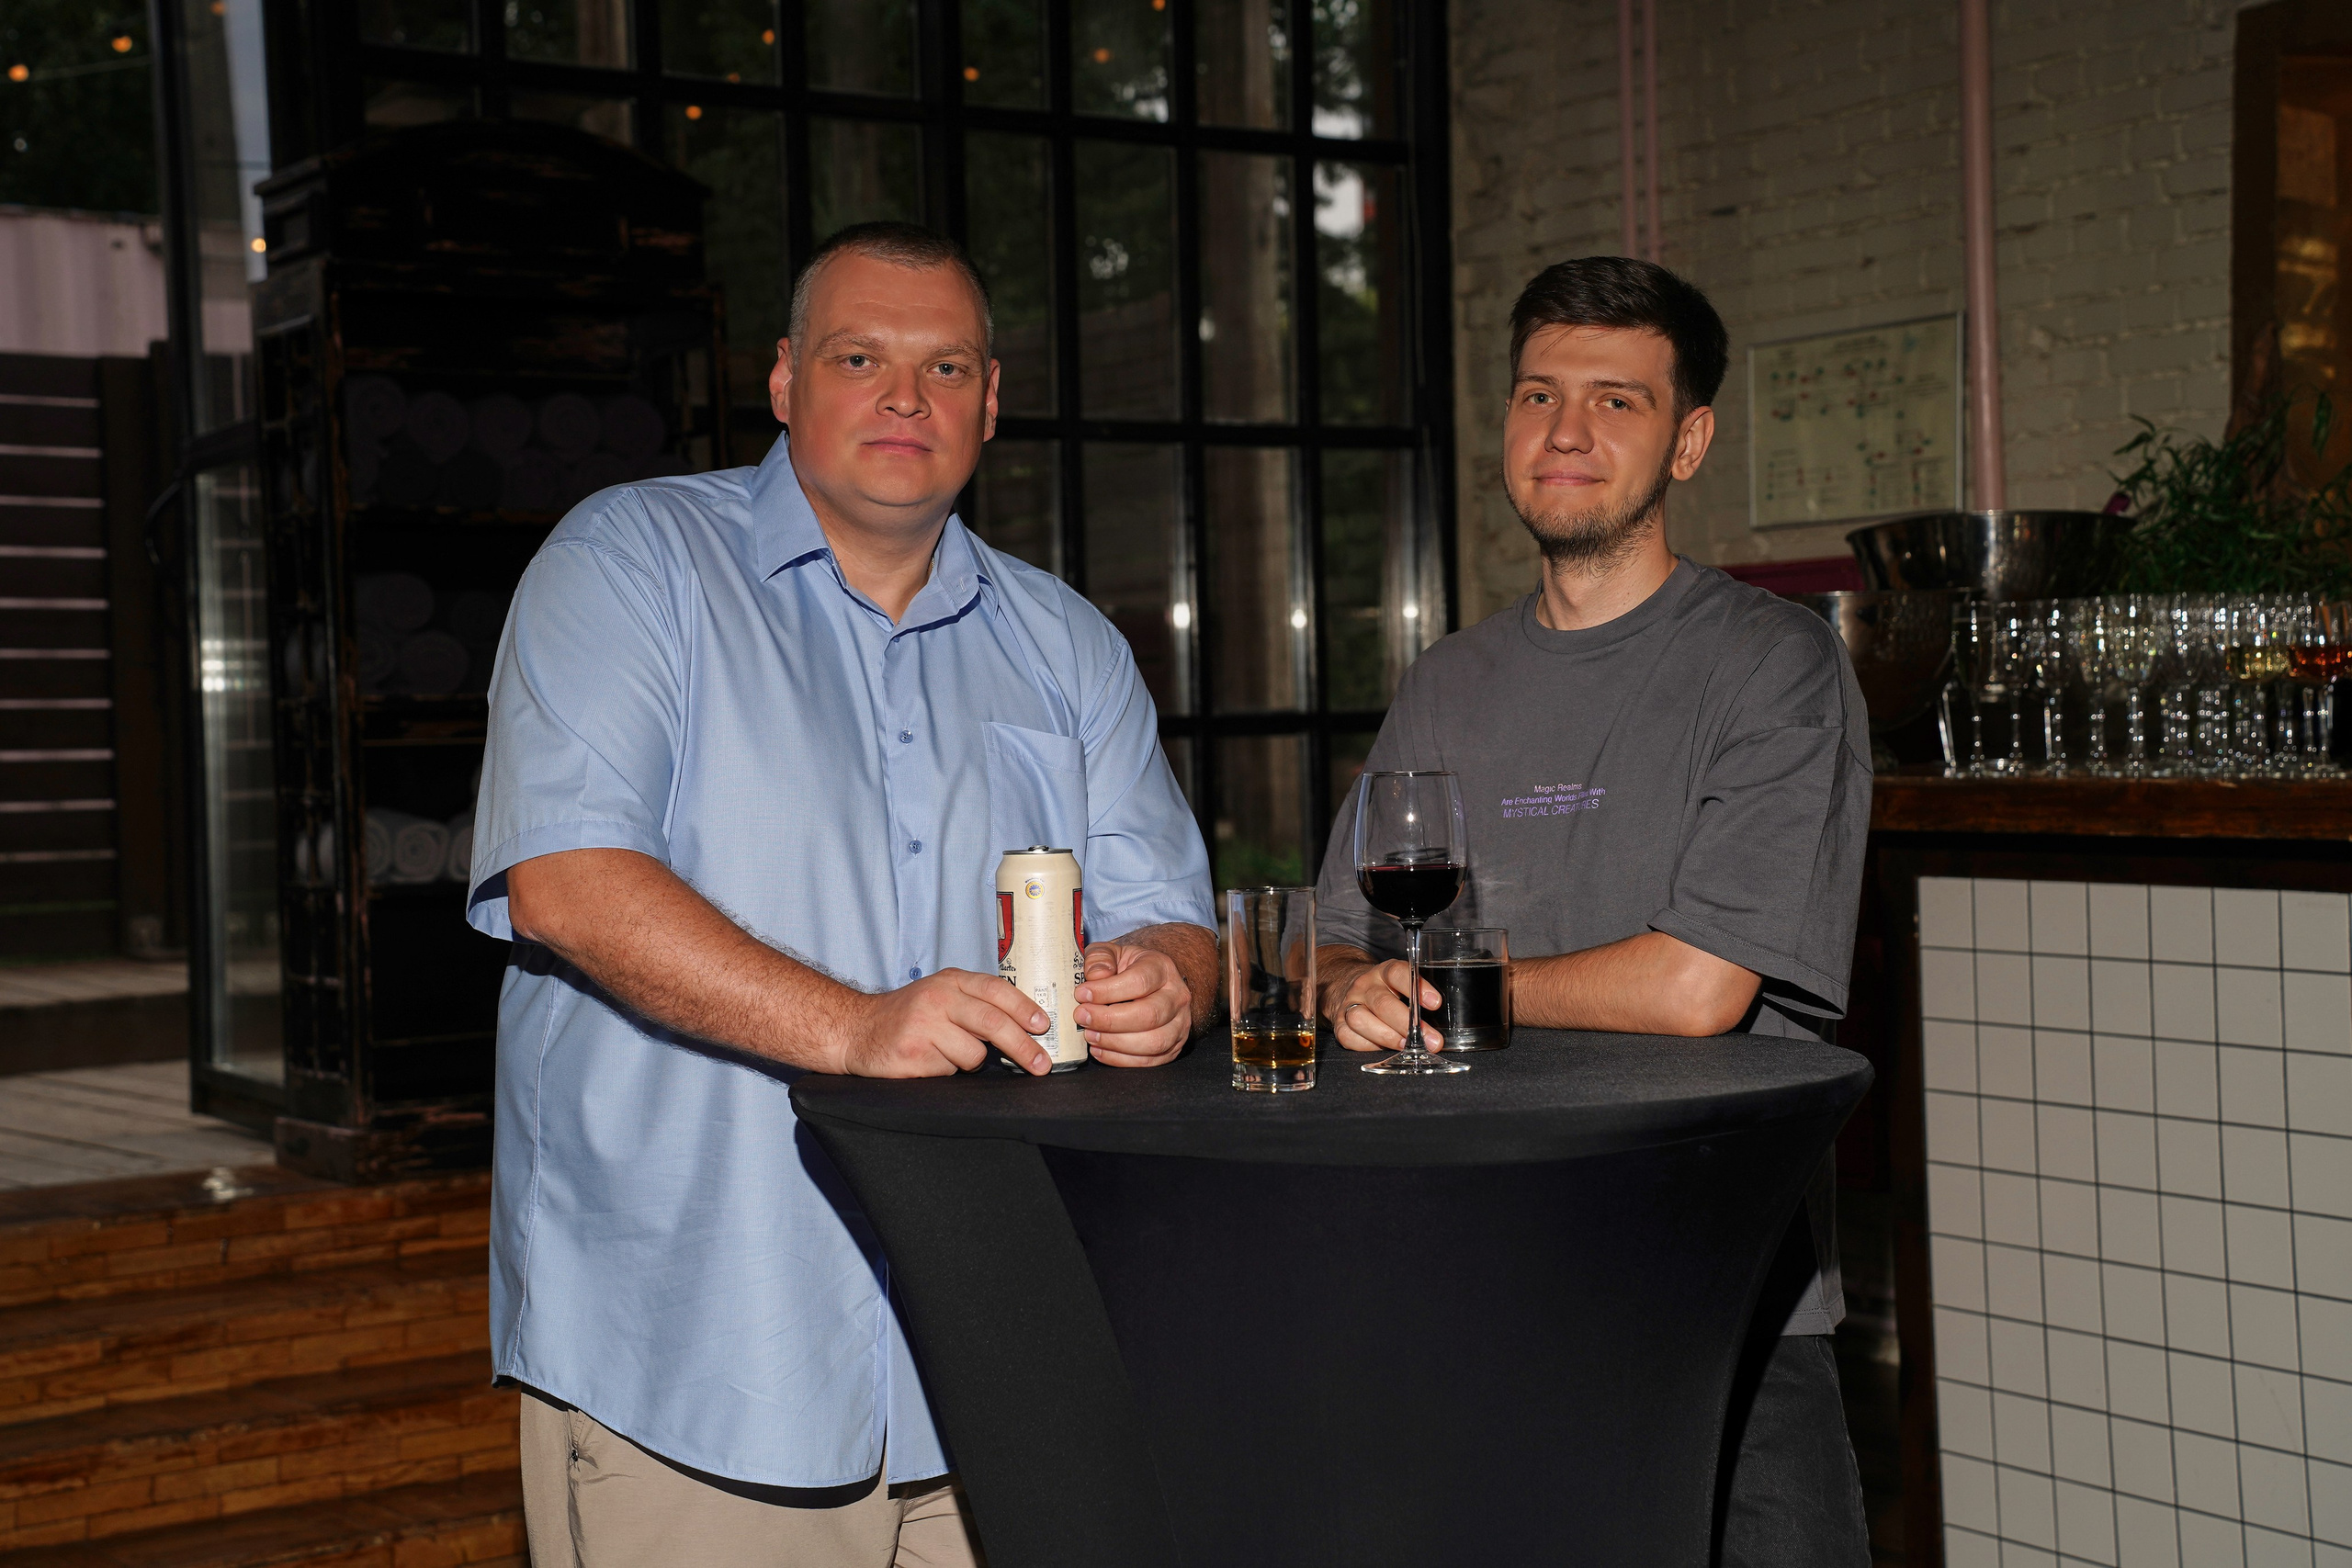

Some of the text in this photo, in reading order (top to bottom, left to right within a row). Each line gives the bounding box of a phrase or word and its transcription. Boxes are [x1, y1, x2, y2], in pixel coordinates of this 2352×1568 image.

[1534, 783, 1582, 795] Magic Realms
[1514, 795, 1553, 805] Enchanting
[1555, 794, 1577, 802] Worlds
[1589, 787, 1606, 796] With
[1503, 806, 1549, 818] MYSTICAL
